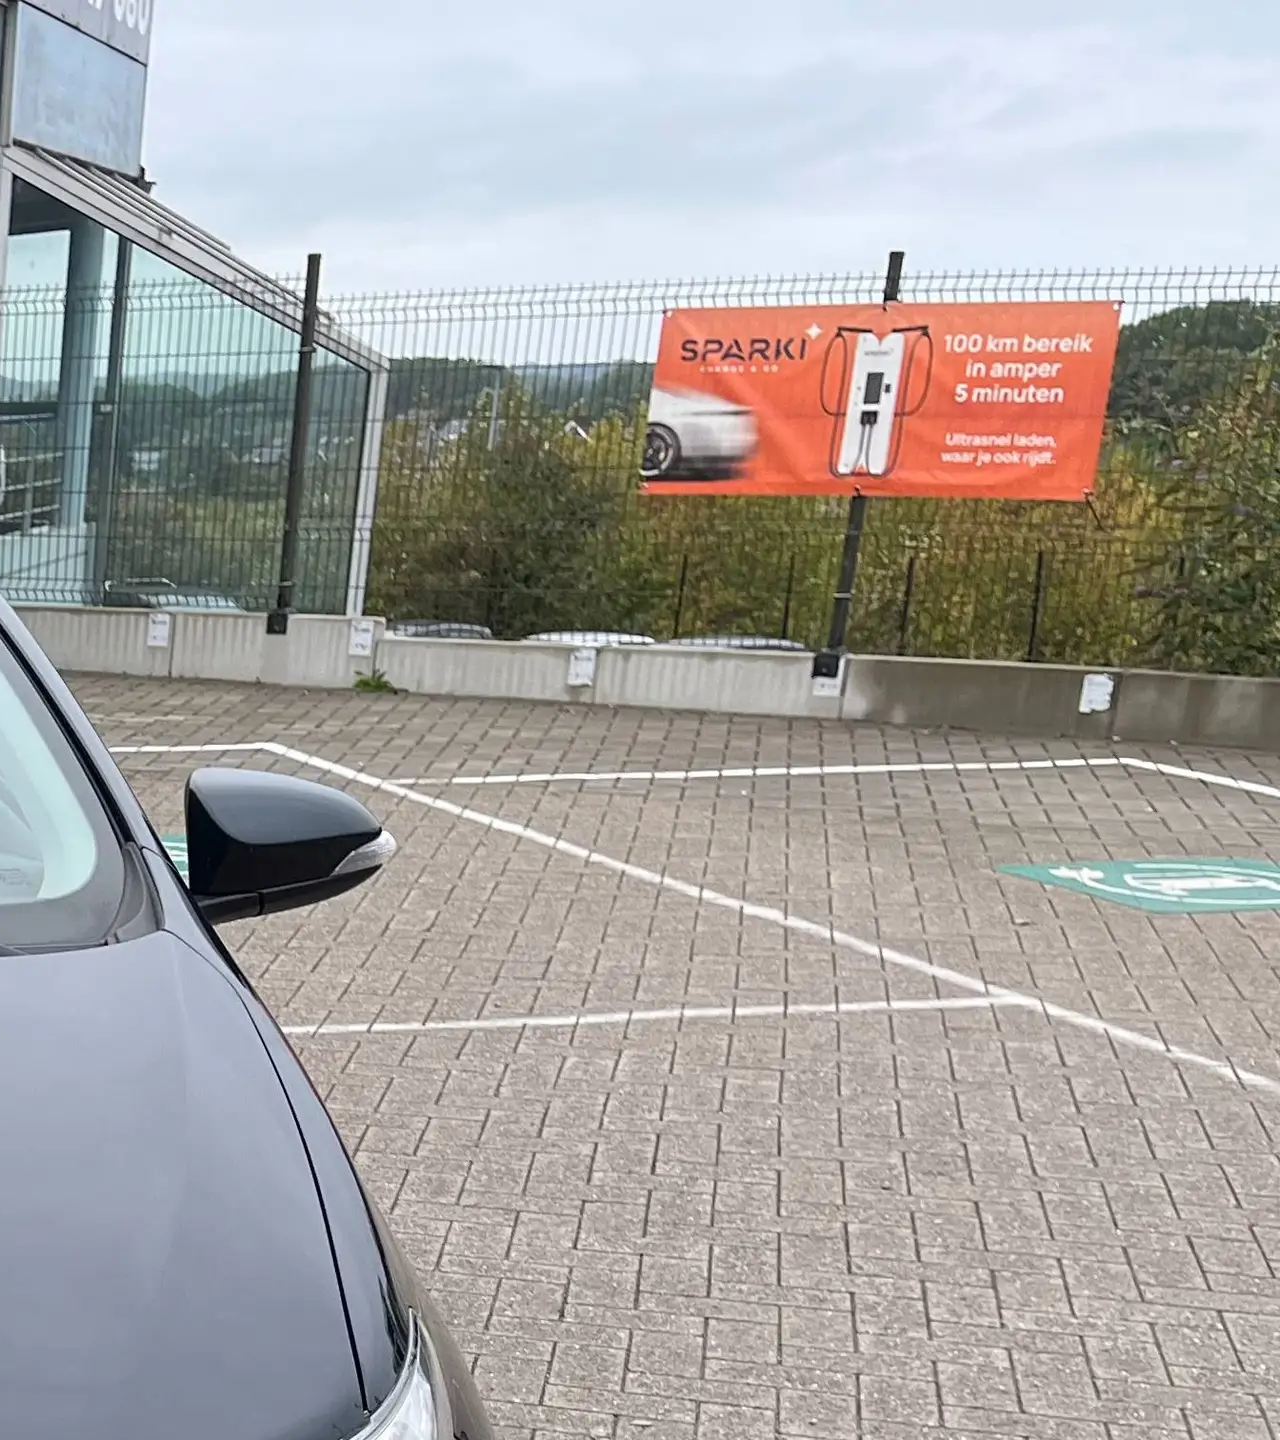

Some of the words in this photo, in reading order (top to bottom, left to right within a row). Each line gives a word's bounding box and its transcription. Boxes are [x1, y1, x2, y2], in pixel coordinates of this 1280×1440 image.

[681, 338, 807, 362] SPARKI
[944, 334, 982, 353] 100
[986, 334, 1018, 353] km
[1023, 334, 1094, 353] bereik
[965, 358, 986, 378] in
[990, 361, 1062, 383] amper
[954, 383, 969, 403] 5
[972, 384, 1064, 403] minuten
